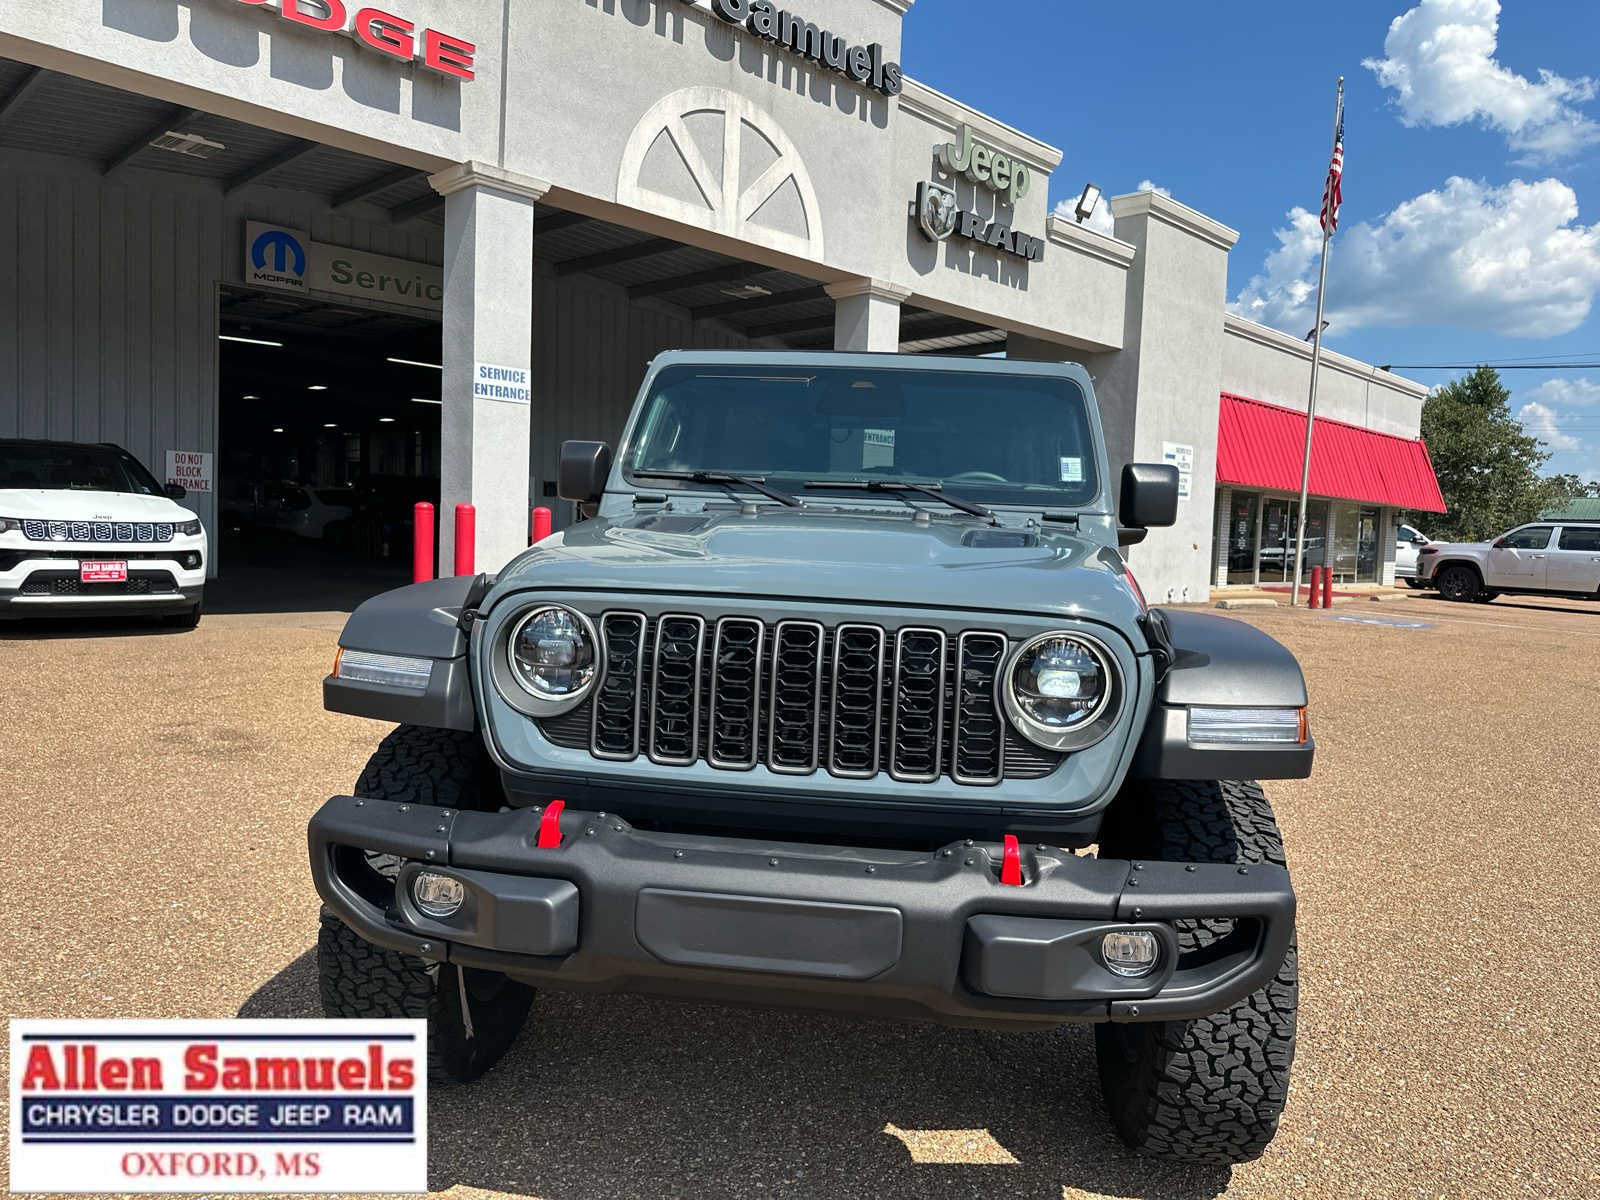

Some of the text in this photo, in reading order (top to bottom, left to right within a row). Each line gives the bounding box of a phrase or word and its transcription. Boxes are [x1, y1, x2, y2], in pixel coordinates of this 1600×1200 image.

[233, 0, 476, 81] DGE
[941, 123, 1031, 204] Jeep
[956, 211, 1045, 262] RAM
[254, 272, 304, 287] MOPAR
[480, 366, 526, 384] SERVICE
[475, 382, 530, 401] ENTRANCE
[175, 453, 203, 465] DO NOT
[176, 465, 202, 478] BLOCK
[168, 478, 210, 490] ENTRANCE
